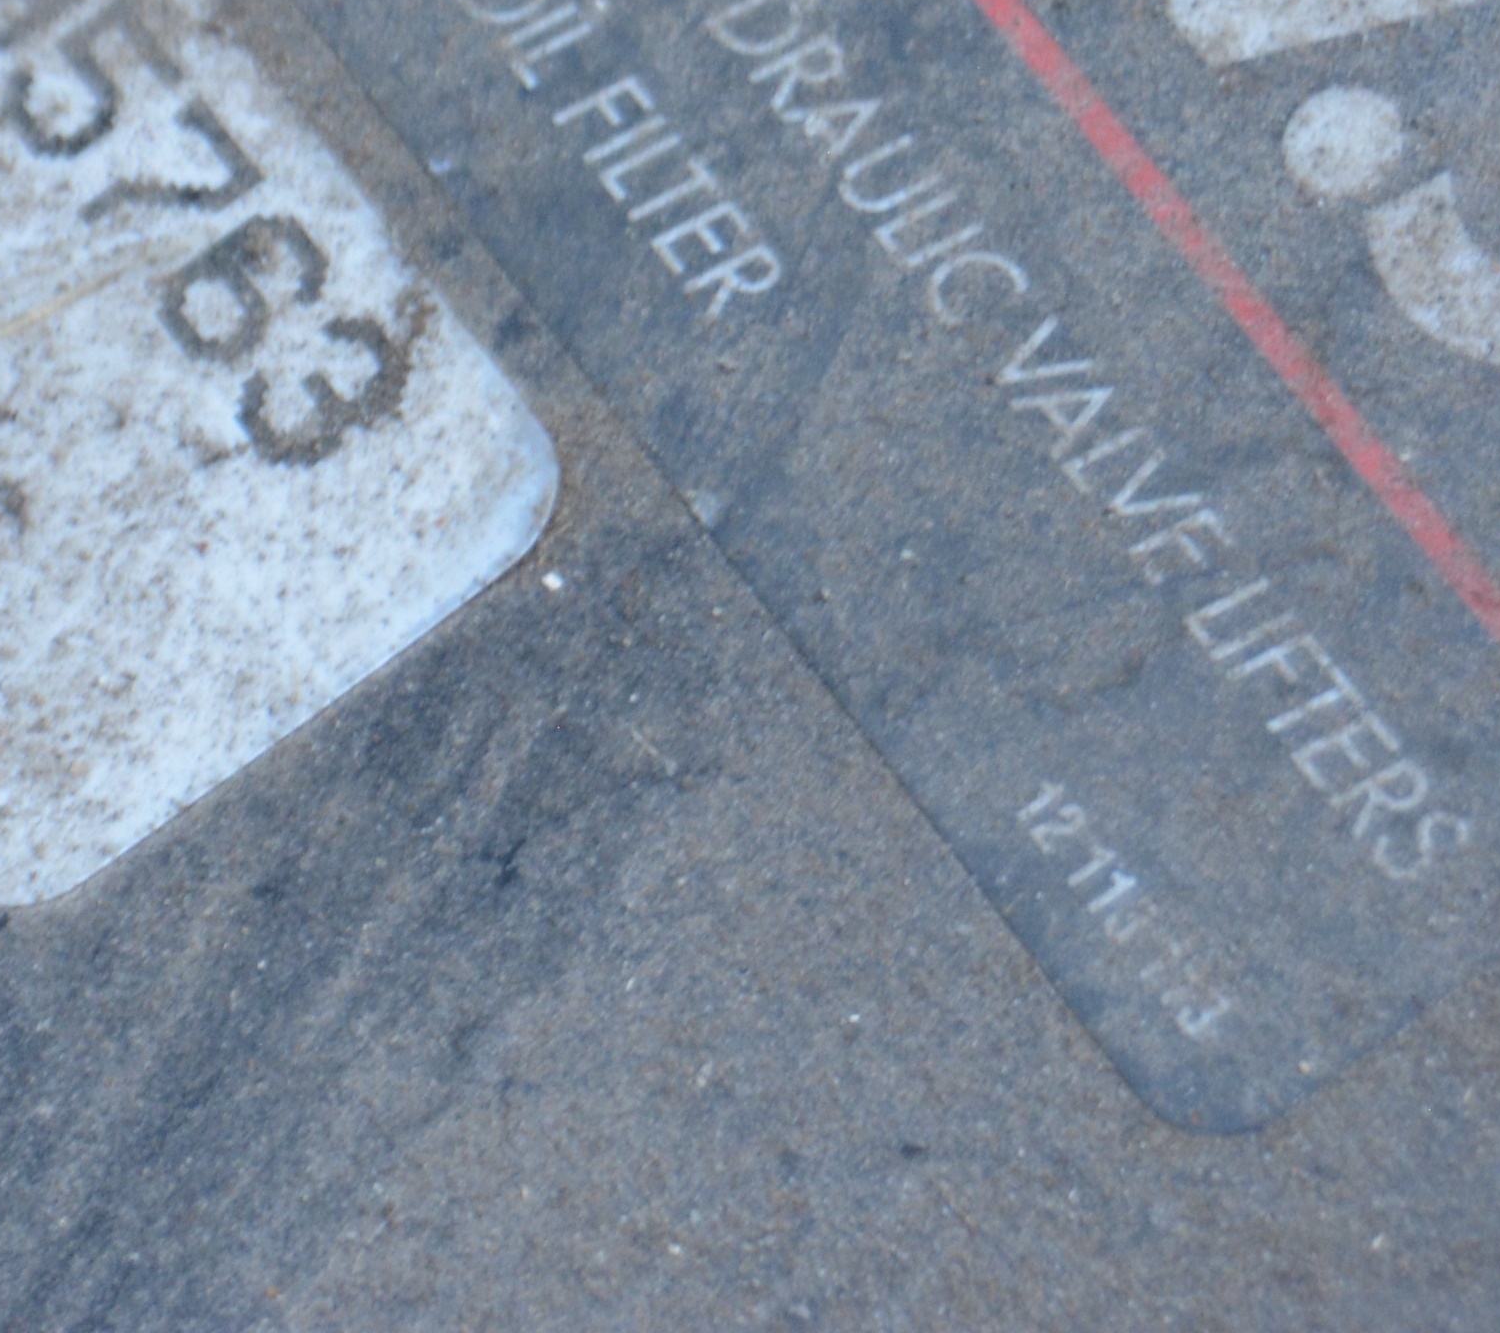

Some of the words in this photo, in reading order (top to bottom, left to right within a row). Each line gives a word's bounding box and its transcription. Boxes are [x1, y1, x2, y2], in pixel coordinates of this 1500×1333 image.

[550, 76, 785, 324] FILTER
[992, 314, 1233, 586] VALVE
[1181, 578, 1474, 884] LIFTERS
